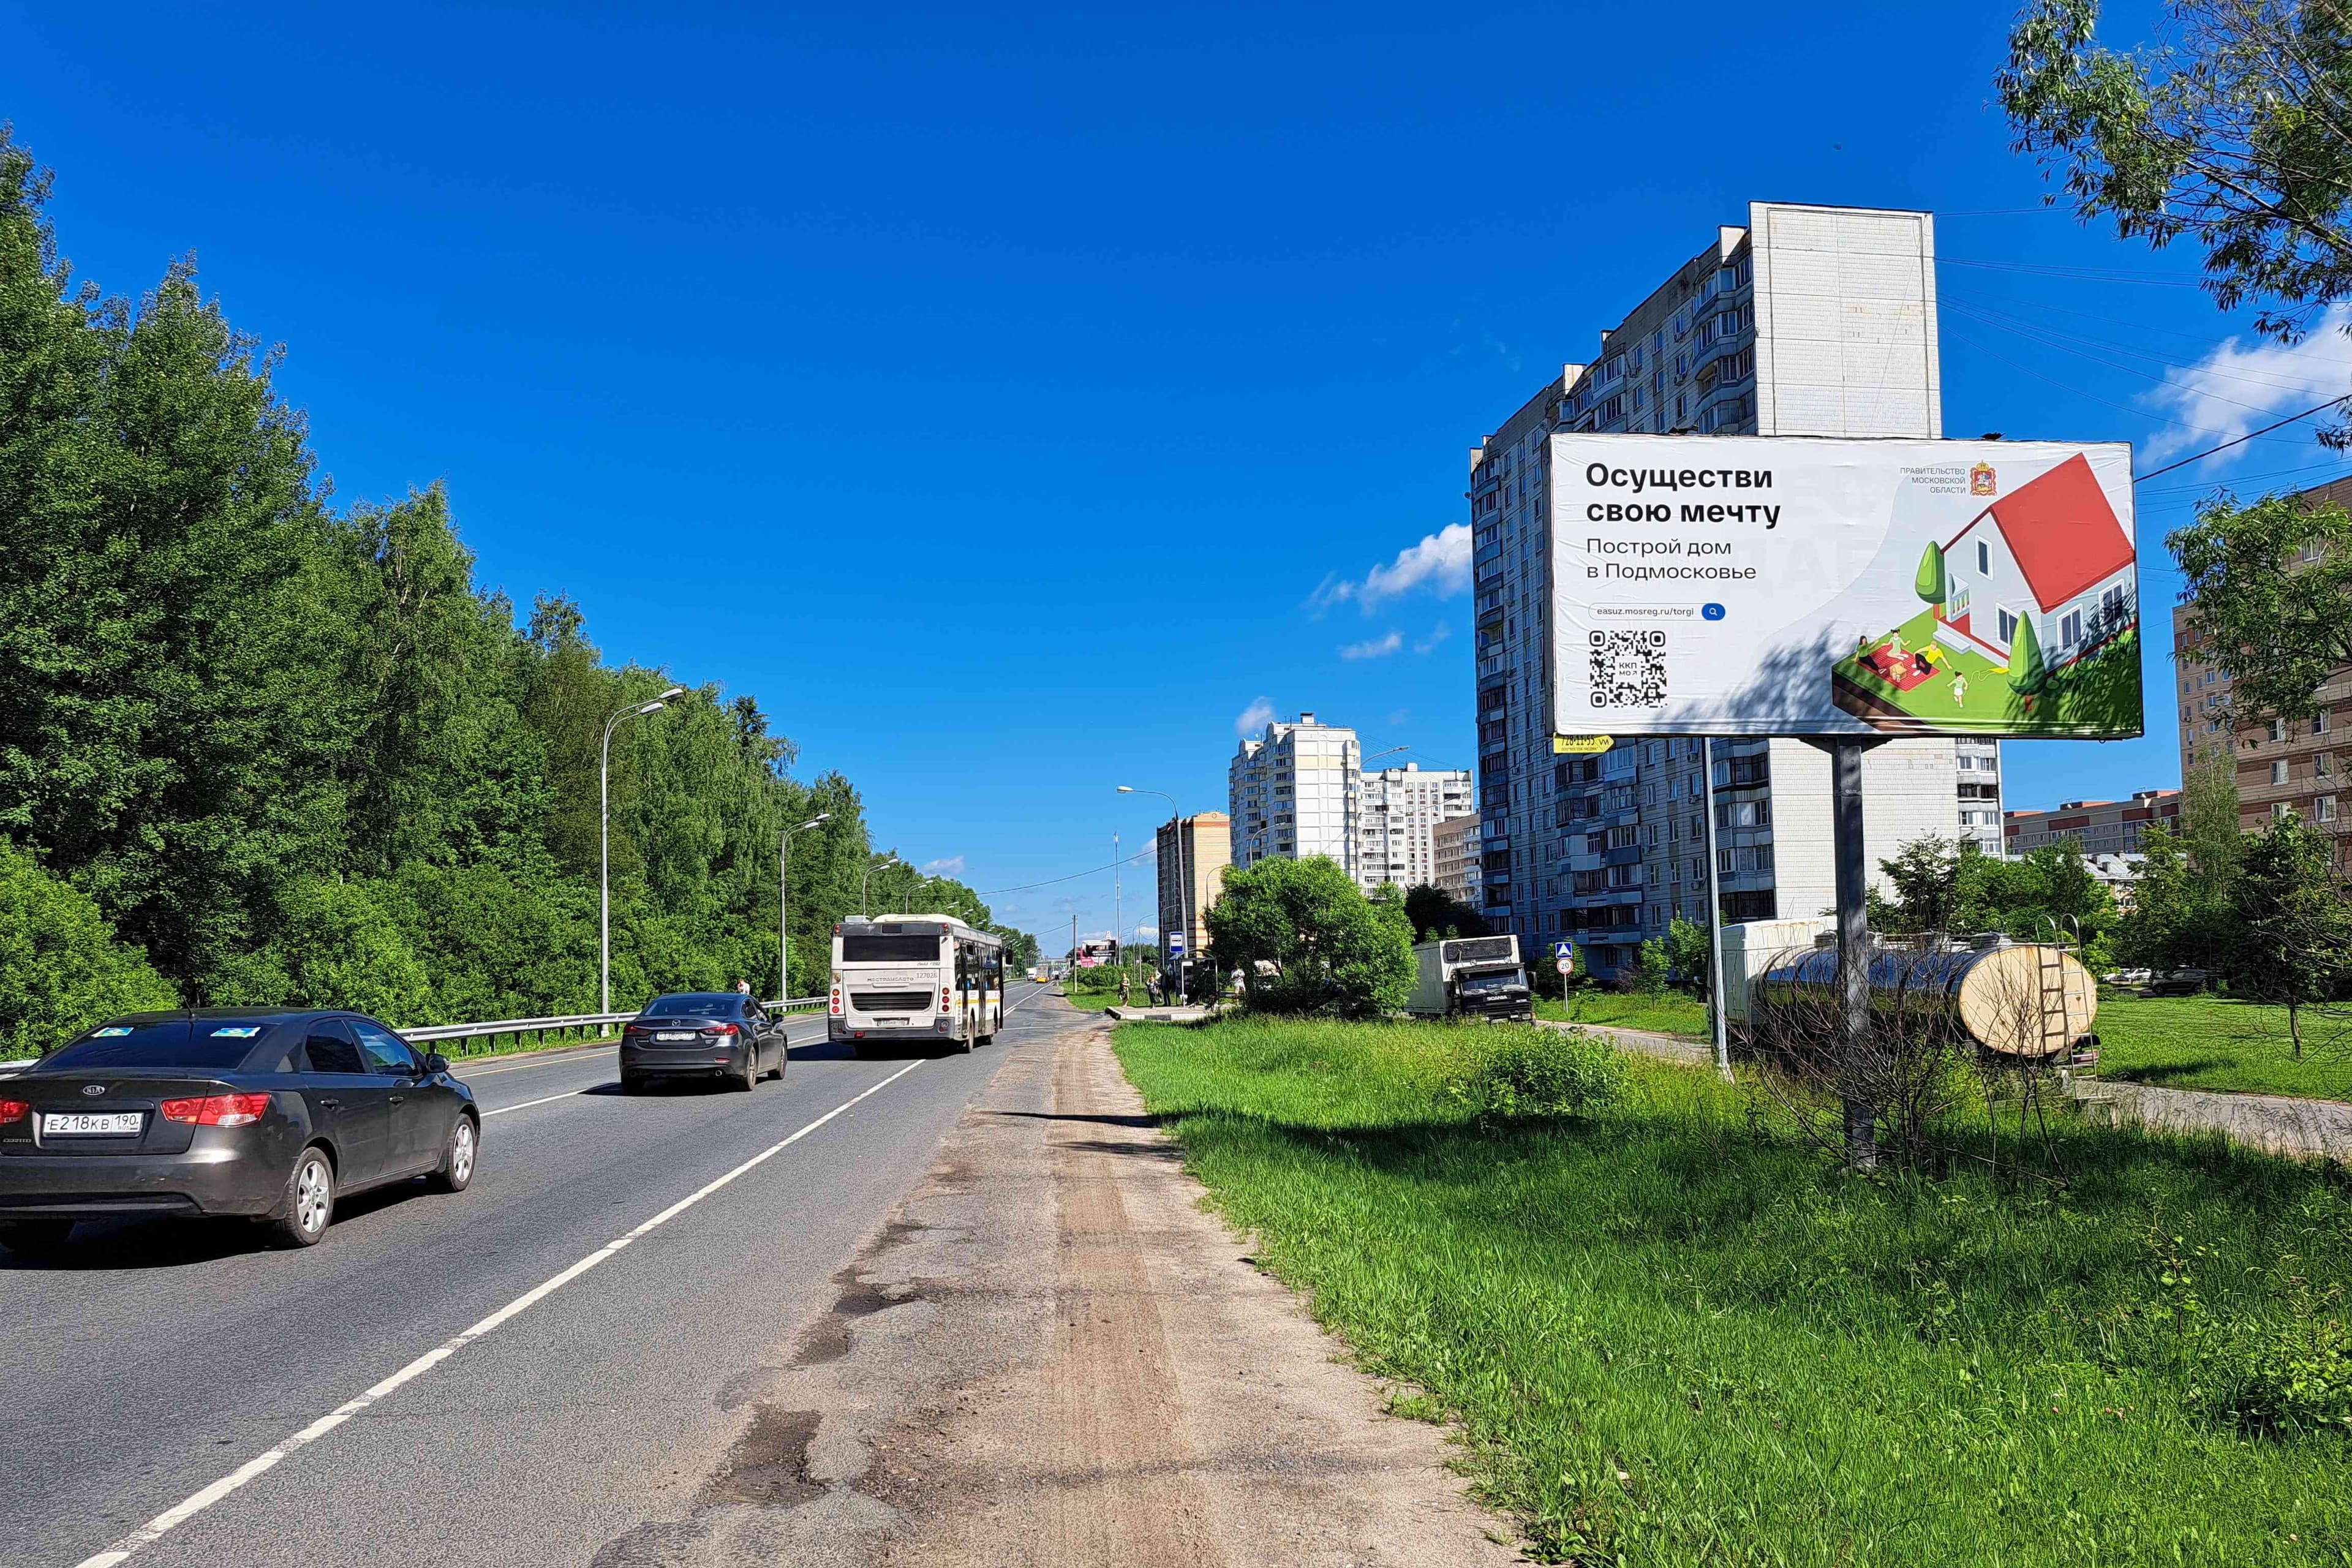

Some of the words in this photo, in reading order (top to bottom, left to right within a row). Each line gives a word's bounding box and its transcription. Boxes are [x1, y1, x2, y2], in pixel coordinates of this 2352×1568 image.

[1586, 462, 1772, 494] Осуществи
[1586, 503, 1672, 522] свою
[1680, 504, 1781, 530] мечту
[1587, 538, 1681, 558] Построй
[1687, 542, 1732, 557] дом
[1587, 566, 1599, 578] в
[1605, 563, 1757, 581] Подмосковье
[1597, 607, 1694, 617] easuz.mosreg.ru/torgi
[114, 1115, 137, 1126] 190
